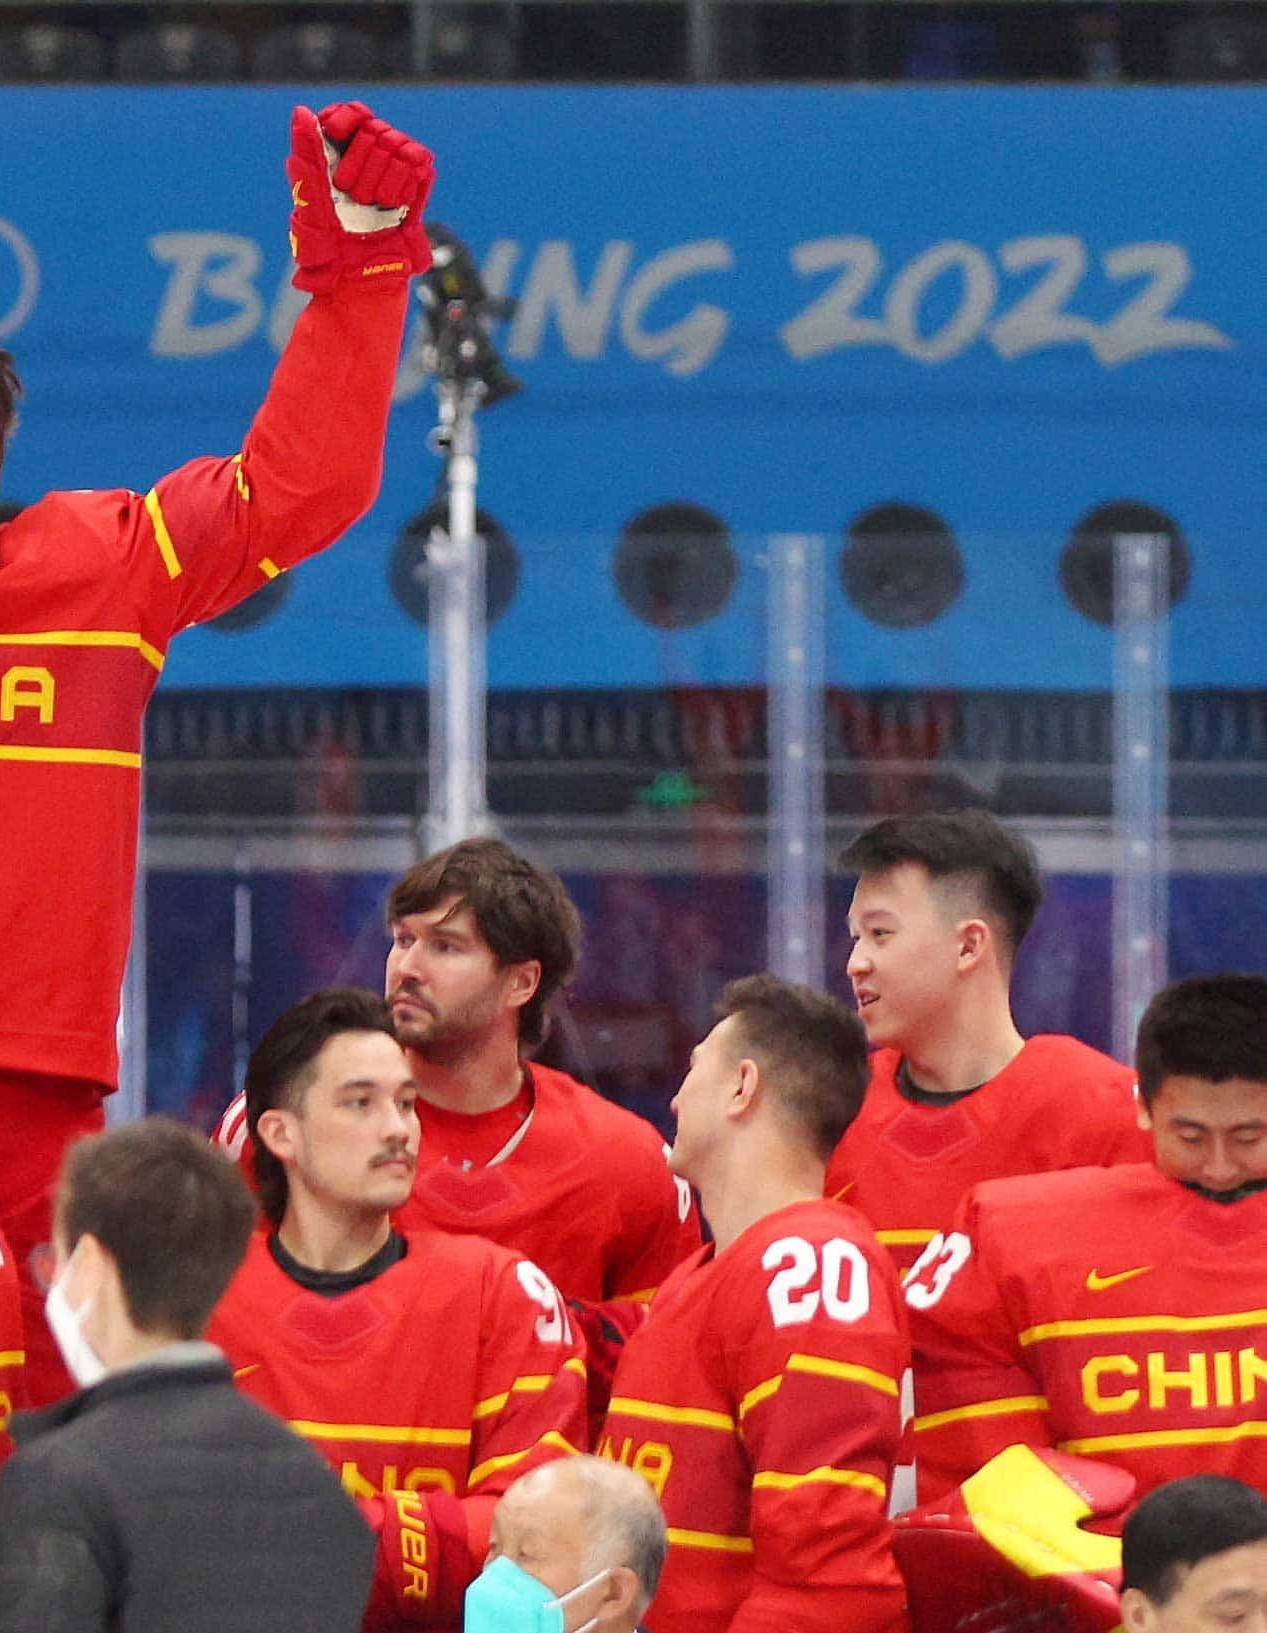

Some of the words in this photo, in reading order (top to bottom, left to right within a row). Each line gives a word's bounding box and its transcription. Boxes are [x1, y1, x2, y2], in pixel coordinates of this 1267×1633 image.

[147, 231, 733, 400] BING
[780, 235, 1236, 369] 2022
[761, 1236, 870, 1329] 20
